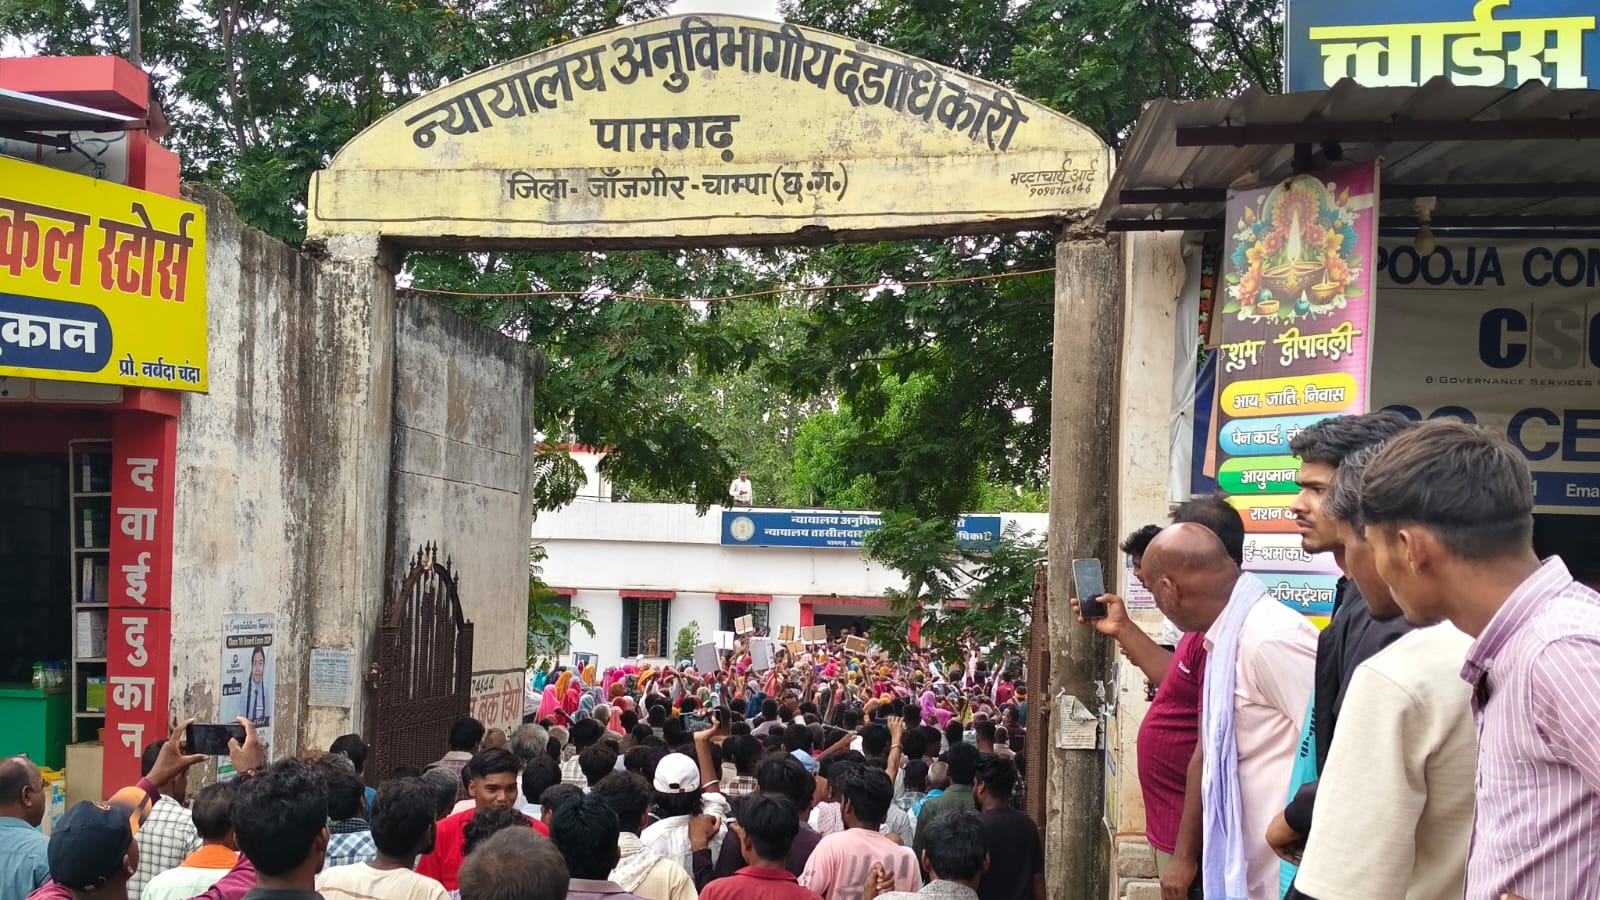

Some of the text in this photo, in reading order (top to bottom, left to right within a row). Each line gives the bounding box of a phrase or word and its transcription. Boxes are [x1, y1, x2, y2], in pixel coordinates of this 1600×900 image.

[405, 46, 607, 149] न्यायालय
[610, 16, 841, 93] अनुविभागीय
[590, 115, 740, 162] पामगढ़
[97, 202, 195, 303] स्टोर्स
[0, 312, 98, 354] कान
[1220, 322, 1362, 372] शुभ दीपावली
[1479, 308, 1600, 370] CS
[119, 353, 139, 377] प्रो.
[1266, 388, 1301, 406] जाति,
[1303, 383, 1345, 403] निवास
[1232, 427, 1252, 445] पेन
[1240, 469, 1297, 490] आयुष्मान
[117, 458, 158, 605] दवाई
[764, 528, 809, 537] न्यायालय
[791, 515, 883, 529] न्यायालय अनुविभा
[1249, 507, 1282, 521] राशन
[110, 616, 155, 758] दुकान
